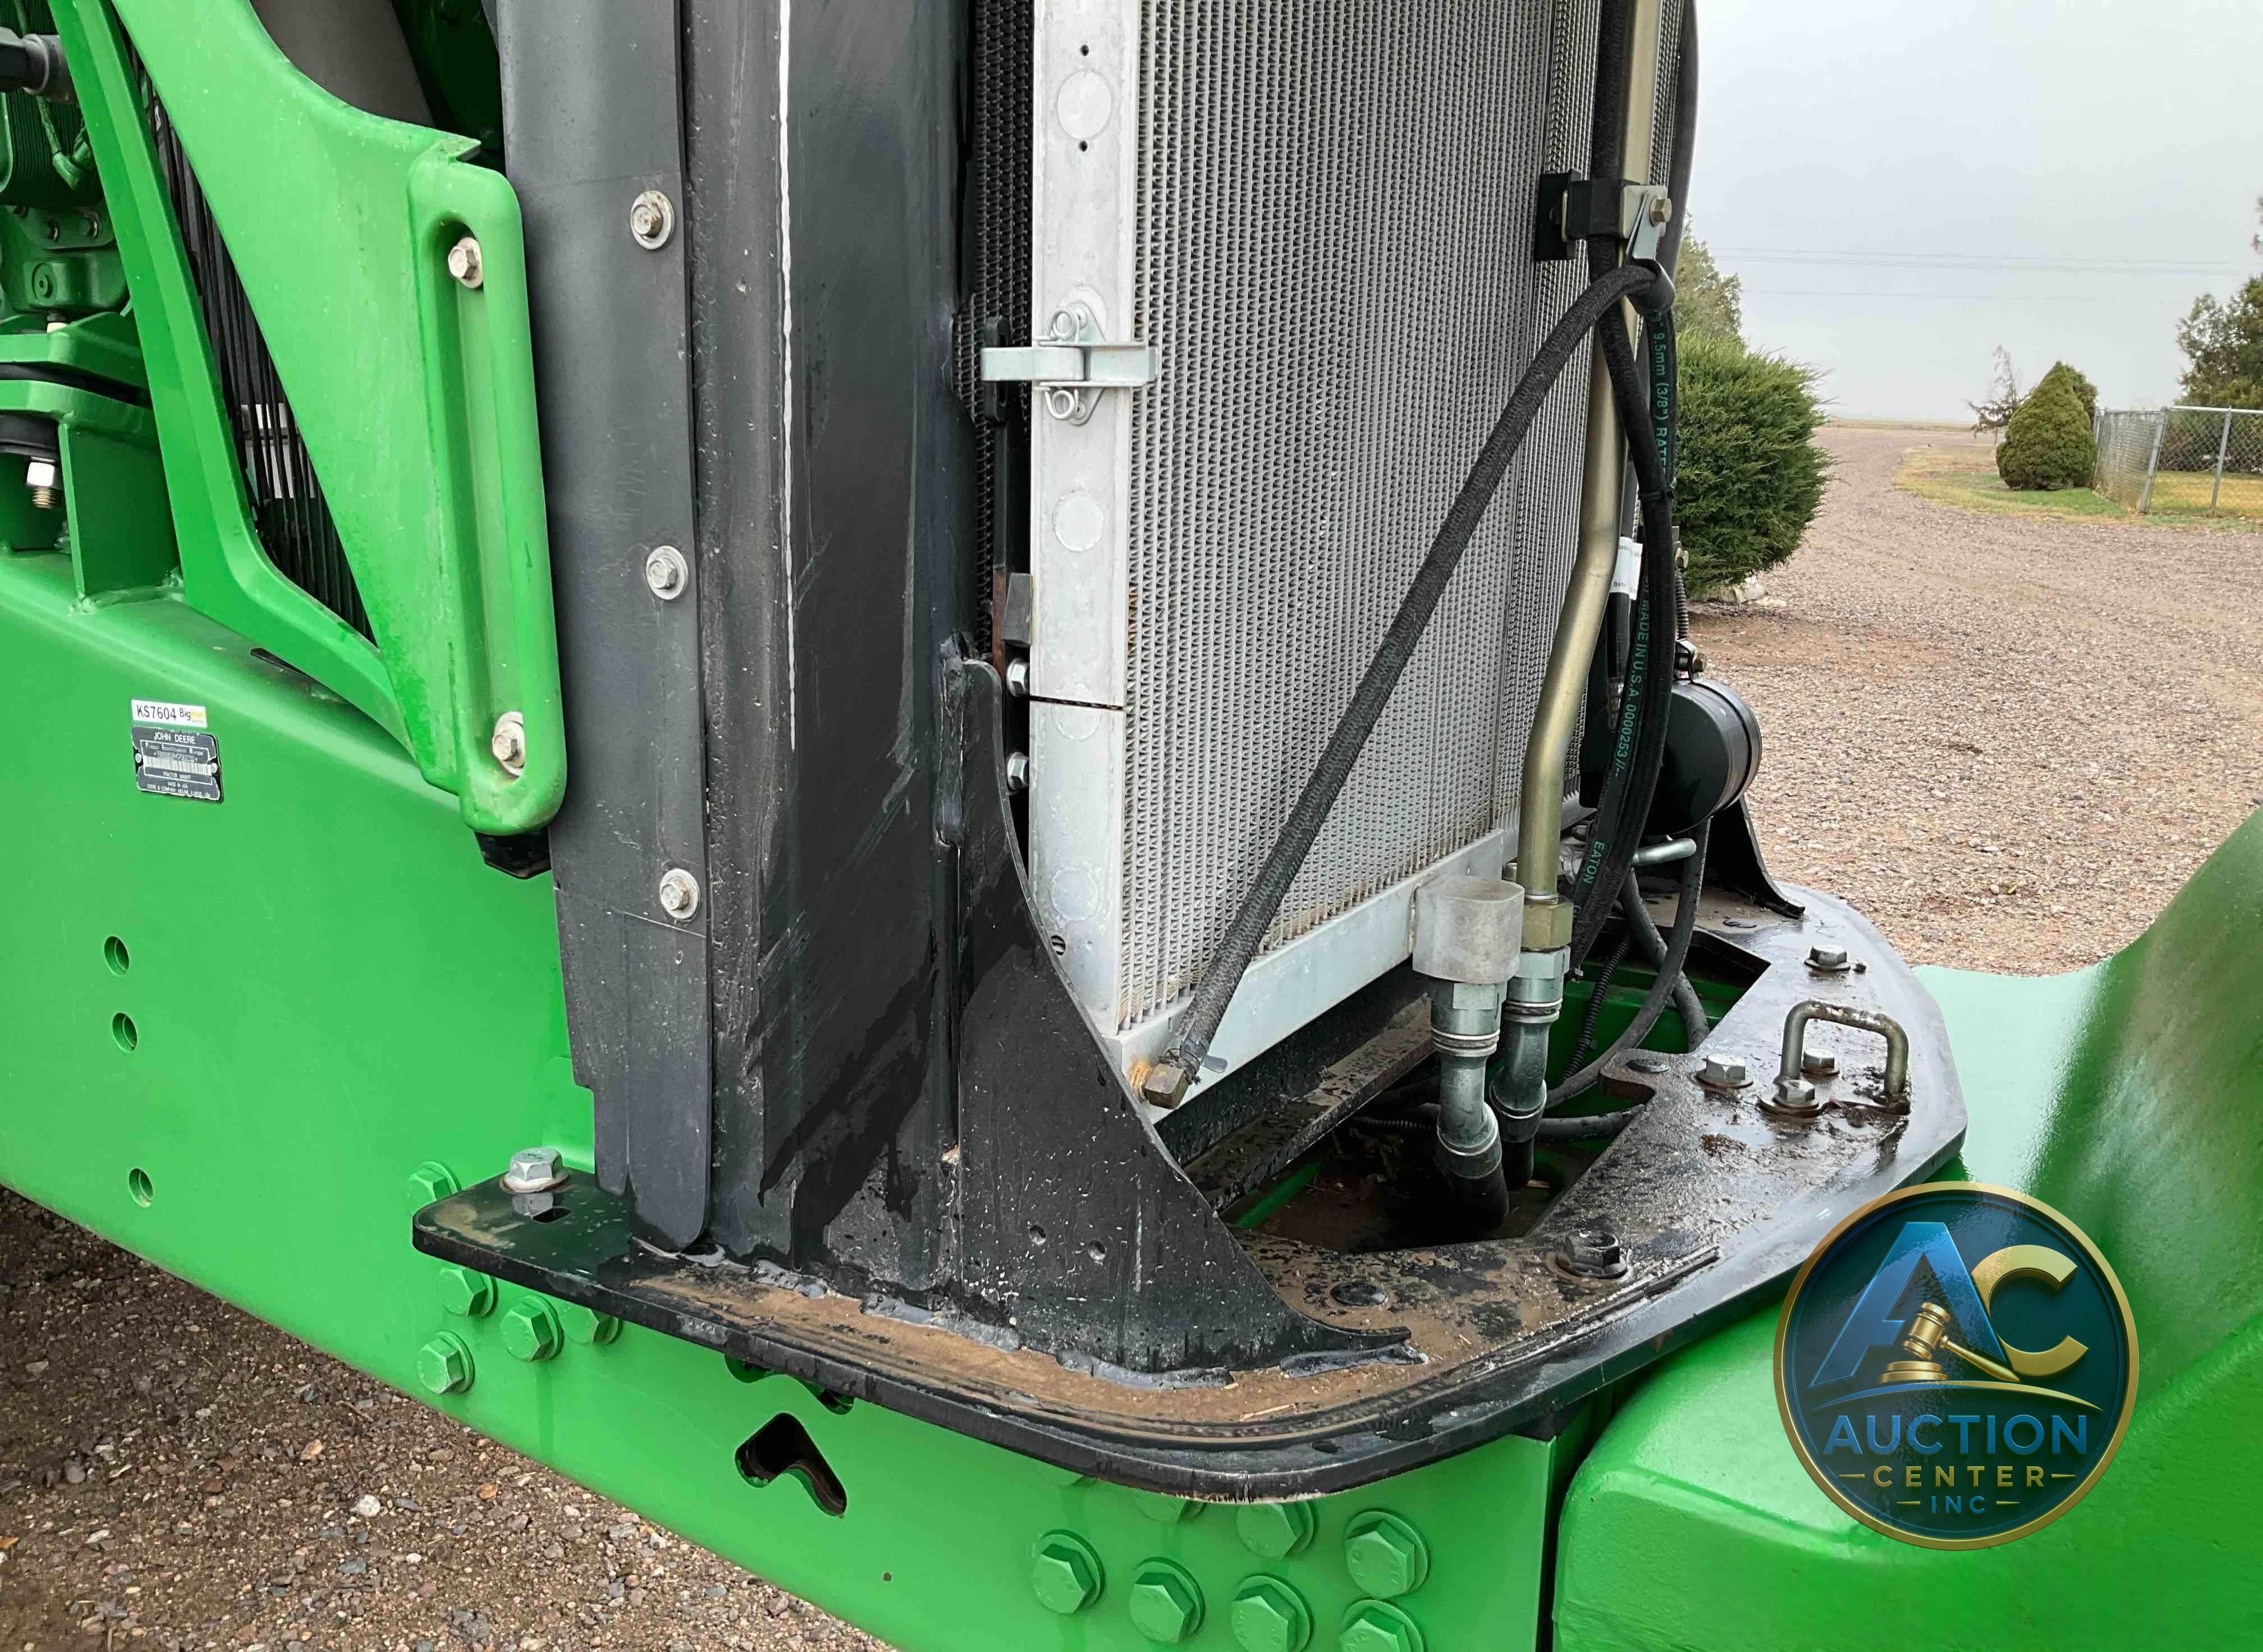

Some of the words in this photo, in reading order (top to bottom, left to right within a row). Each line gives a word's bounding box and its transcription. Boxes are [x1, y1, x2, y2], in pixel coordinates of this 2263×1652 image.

[1653, 332, 1666, 377] 9.5mm
[1656, 382, 1670, 420] (3/8")
[1634, 643, 1646, 658] IN
[1628, 661, 1645, 700] U.S.A.
[136, 704, 176, 720] KS7604
[1617, 704, 1637, 758] 0000253
[154, 732, 171, 741] JOHN
[175, 734, 196, 744] DEERE
[1582, 841, 1605, 884] EATON
